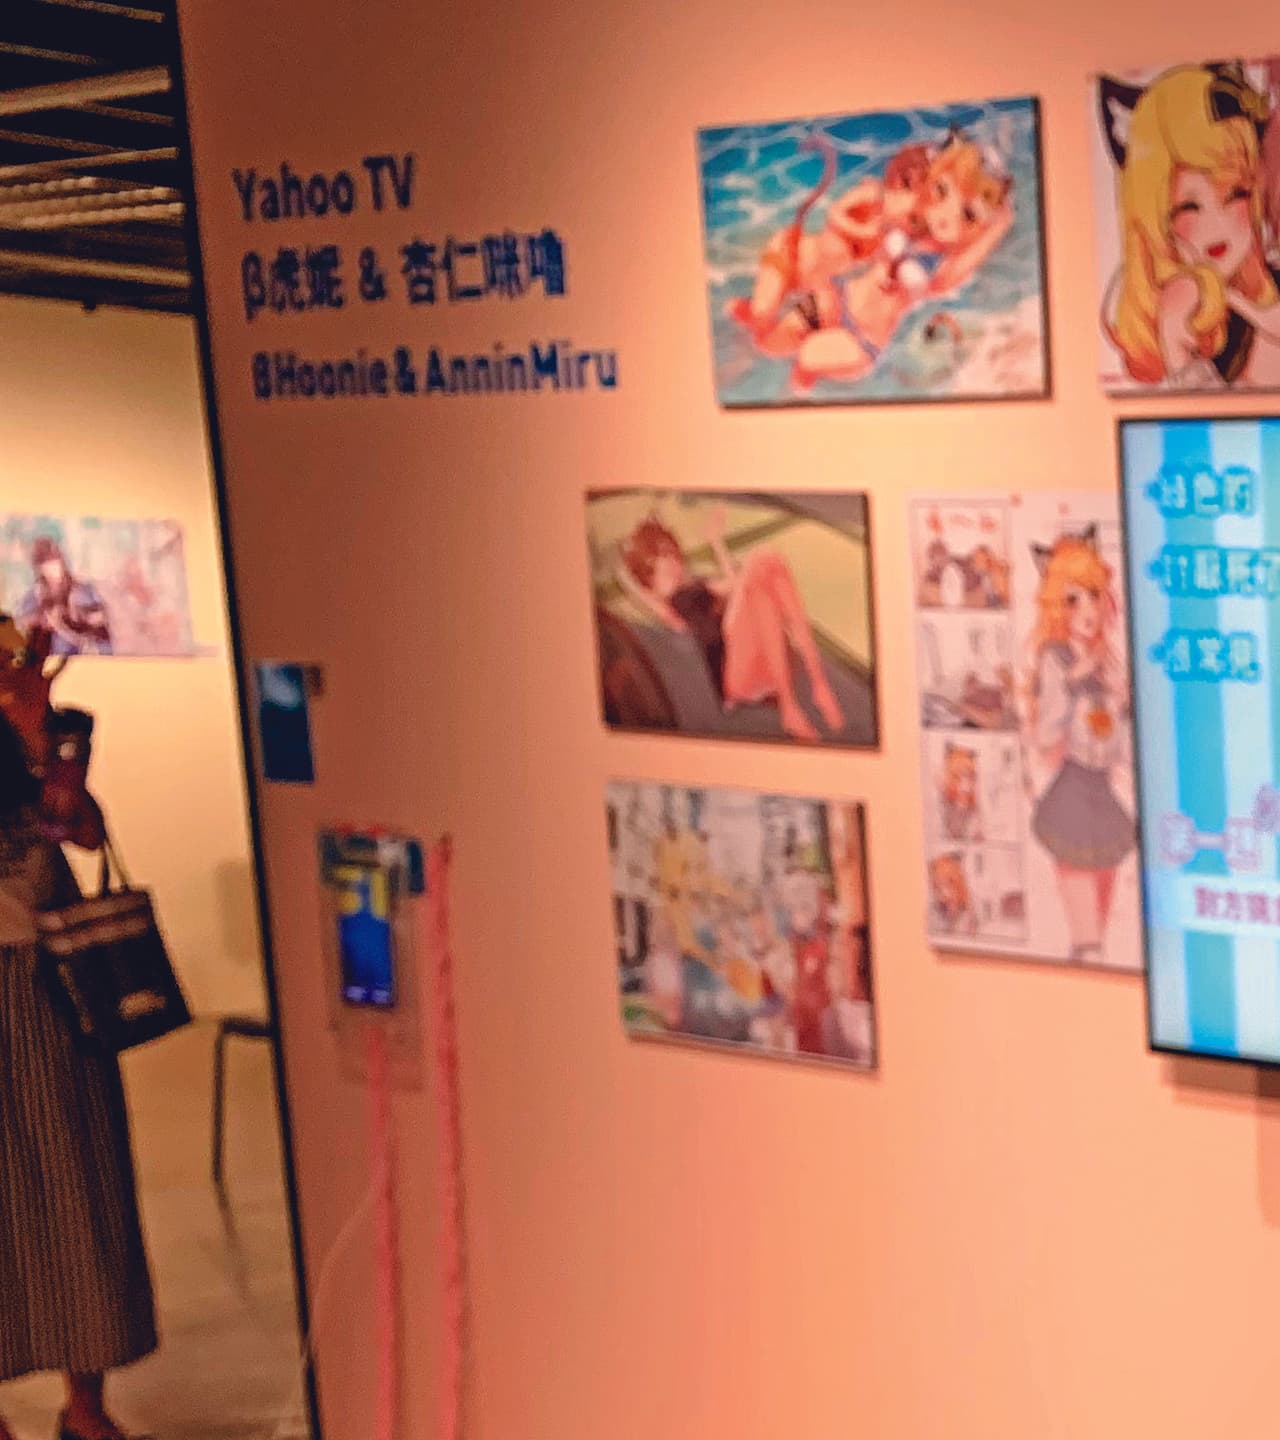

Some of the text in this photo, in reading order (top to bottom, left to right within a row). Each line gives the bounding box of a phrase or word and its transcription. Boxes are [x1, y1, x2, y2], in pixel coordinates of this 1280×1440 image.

[232, 154, 415, 221] Yahoo TV
[359, 247, 386, 299] &
